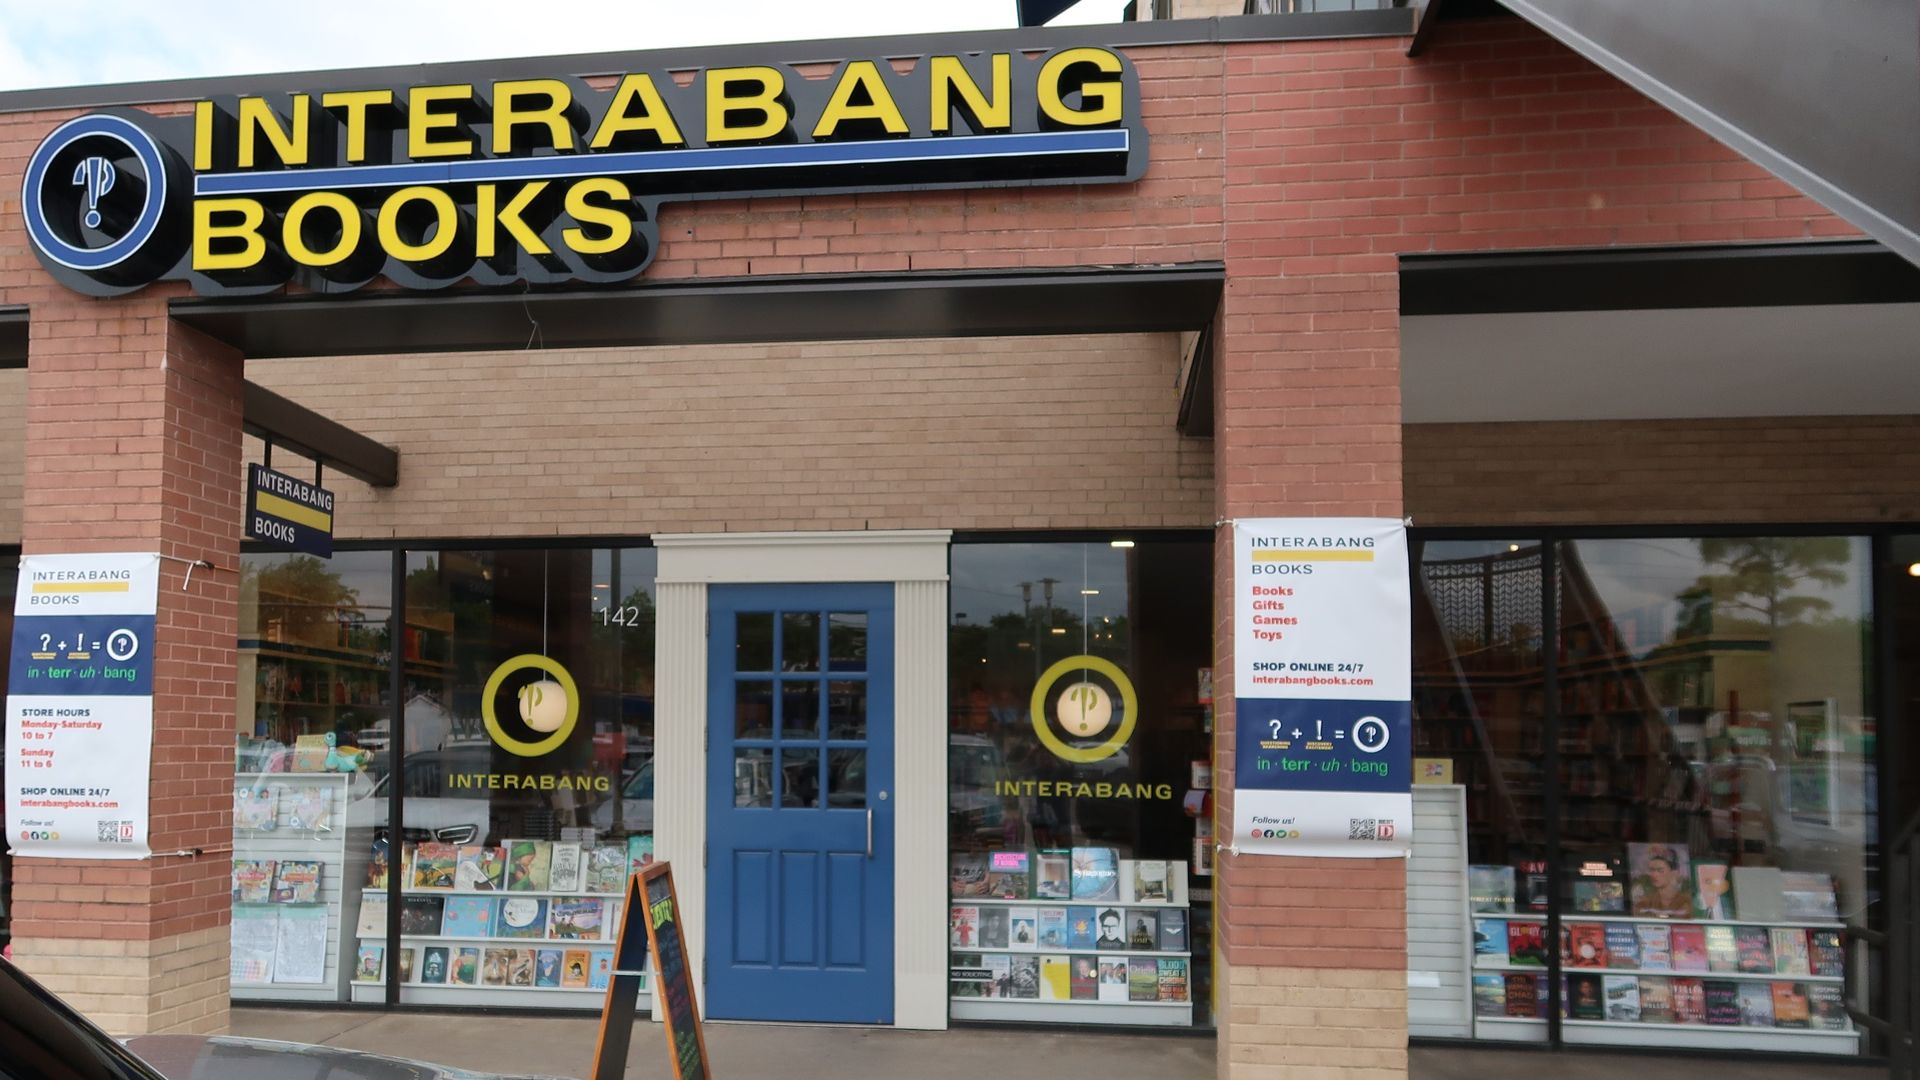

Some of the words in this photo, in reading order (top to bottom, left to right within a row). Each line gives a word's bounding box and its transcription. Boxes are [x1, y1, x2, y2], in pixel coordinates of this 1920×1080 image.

[195, 46, 1124, 171] INTERABANG
[192, 178, 634, 271] BOOKS
[257, 470, 332, 510] INTERABANG
[255, 517, 295, 543] BOOKS
[1251, 537, 1375, 548] INTERABANG
[32, 569, 130, 581] INTERABANG
[1251, 564, 1313, 575] BOOKS
[1252, 585, 1294, 596] Books
[30, 595, 80, 605] BOOKS
[1252, 600, 1285, 610] Gifts
[599, 606, 639, 627] 142
[1252, 614, 1298, 625] Games
[1252, 629, 1283, 641] Toys
[1253, 662, 1286, 671] SHOP
[1289, 662, 1335, 672] ONLINE
[1337, 664, 1364, 674] 24/7
[1252, 675, 1374, 687] interabangbooks.com
[22, 708, 54, 717] STORE
[56, 708, 91, 717] HOURS
[21, 720, 102, 730] Monday-Saturday
[22, 732, 32, 740] 10
[35, 732, 44, 740] to
[47, 732, 53, 740] 7
[20, 748, 54, 758] Sunday
[21, 760, 31, 768] 11
[34, 760, 43, 768] to
[46, 760, 52, 768] 6
[448, 773, 610, 791] INTERABANG
[20, 787, 47, 796] SHOP
[50, 787, 86, 796] ONLINE
[88, 788, 110, 797] 24/7
[994, 780, 1173, 800] INTERABANG
[20, 799, 119, 809] interabangbooks.com
[20, 819, 43, 827] Follow
[1251, 816, 1281, 825] Follow
[1282, 817, 1296, 825] us!
